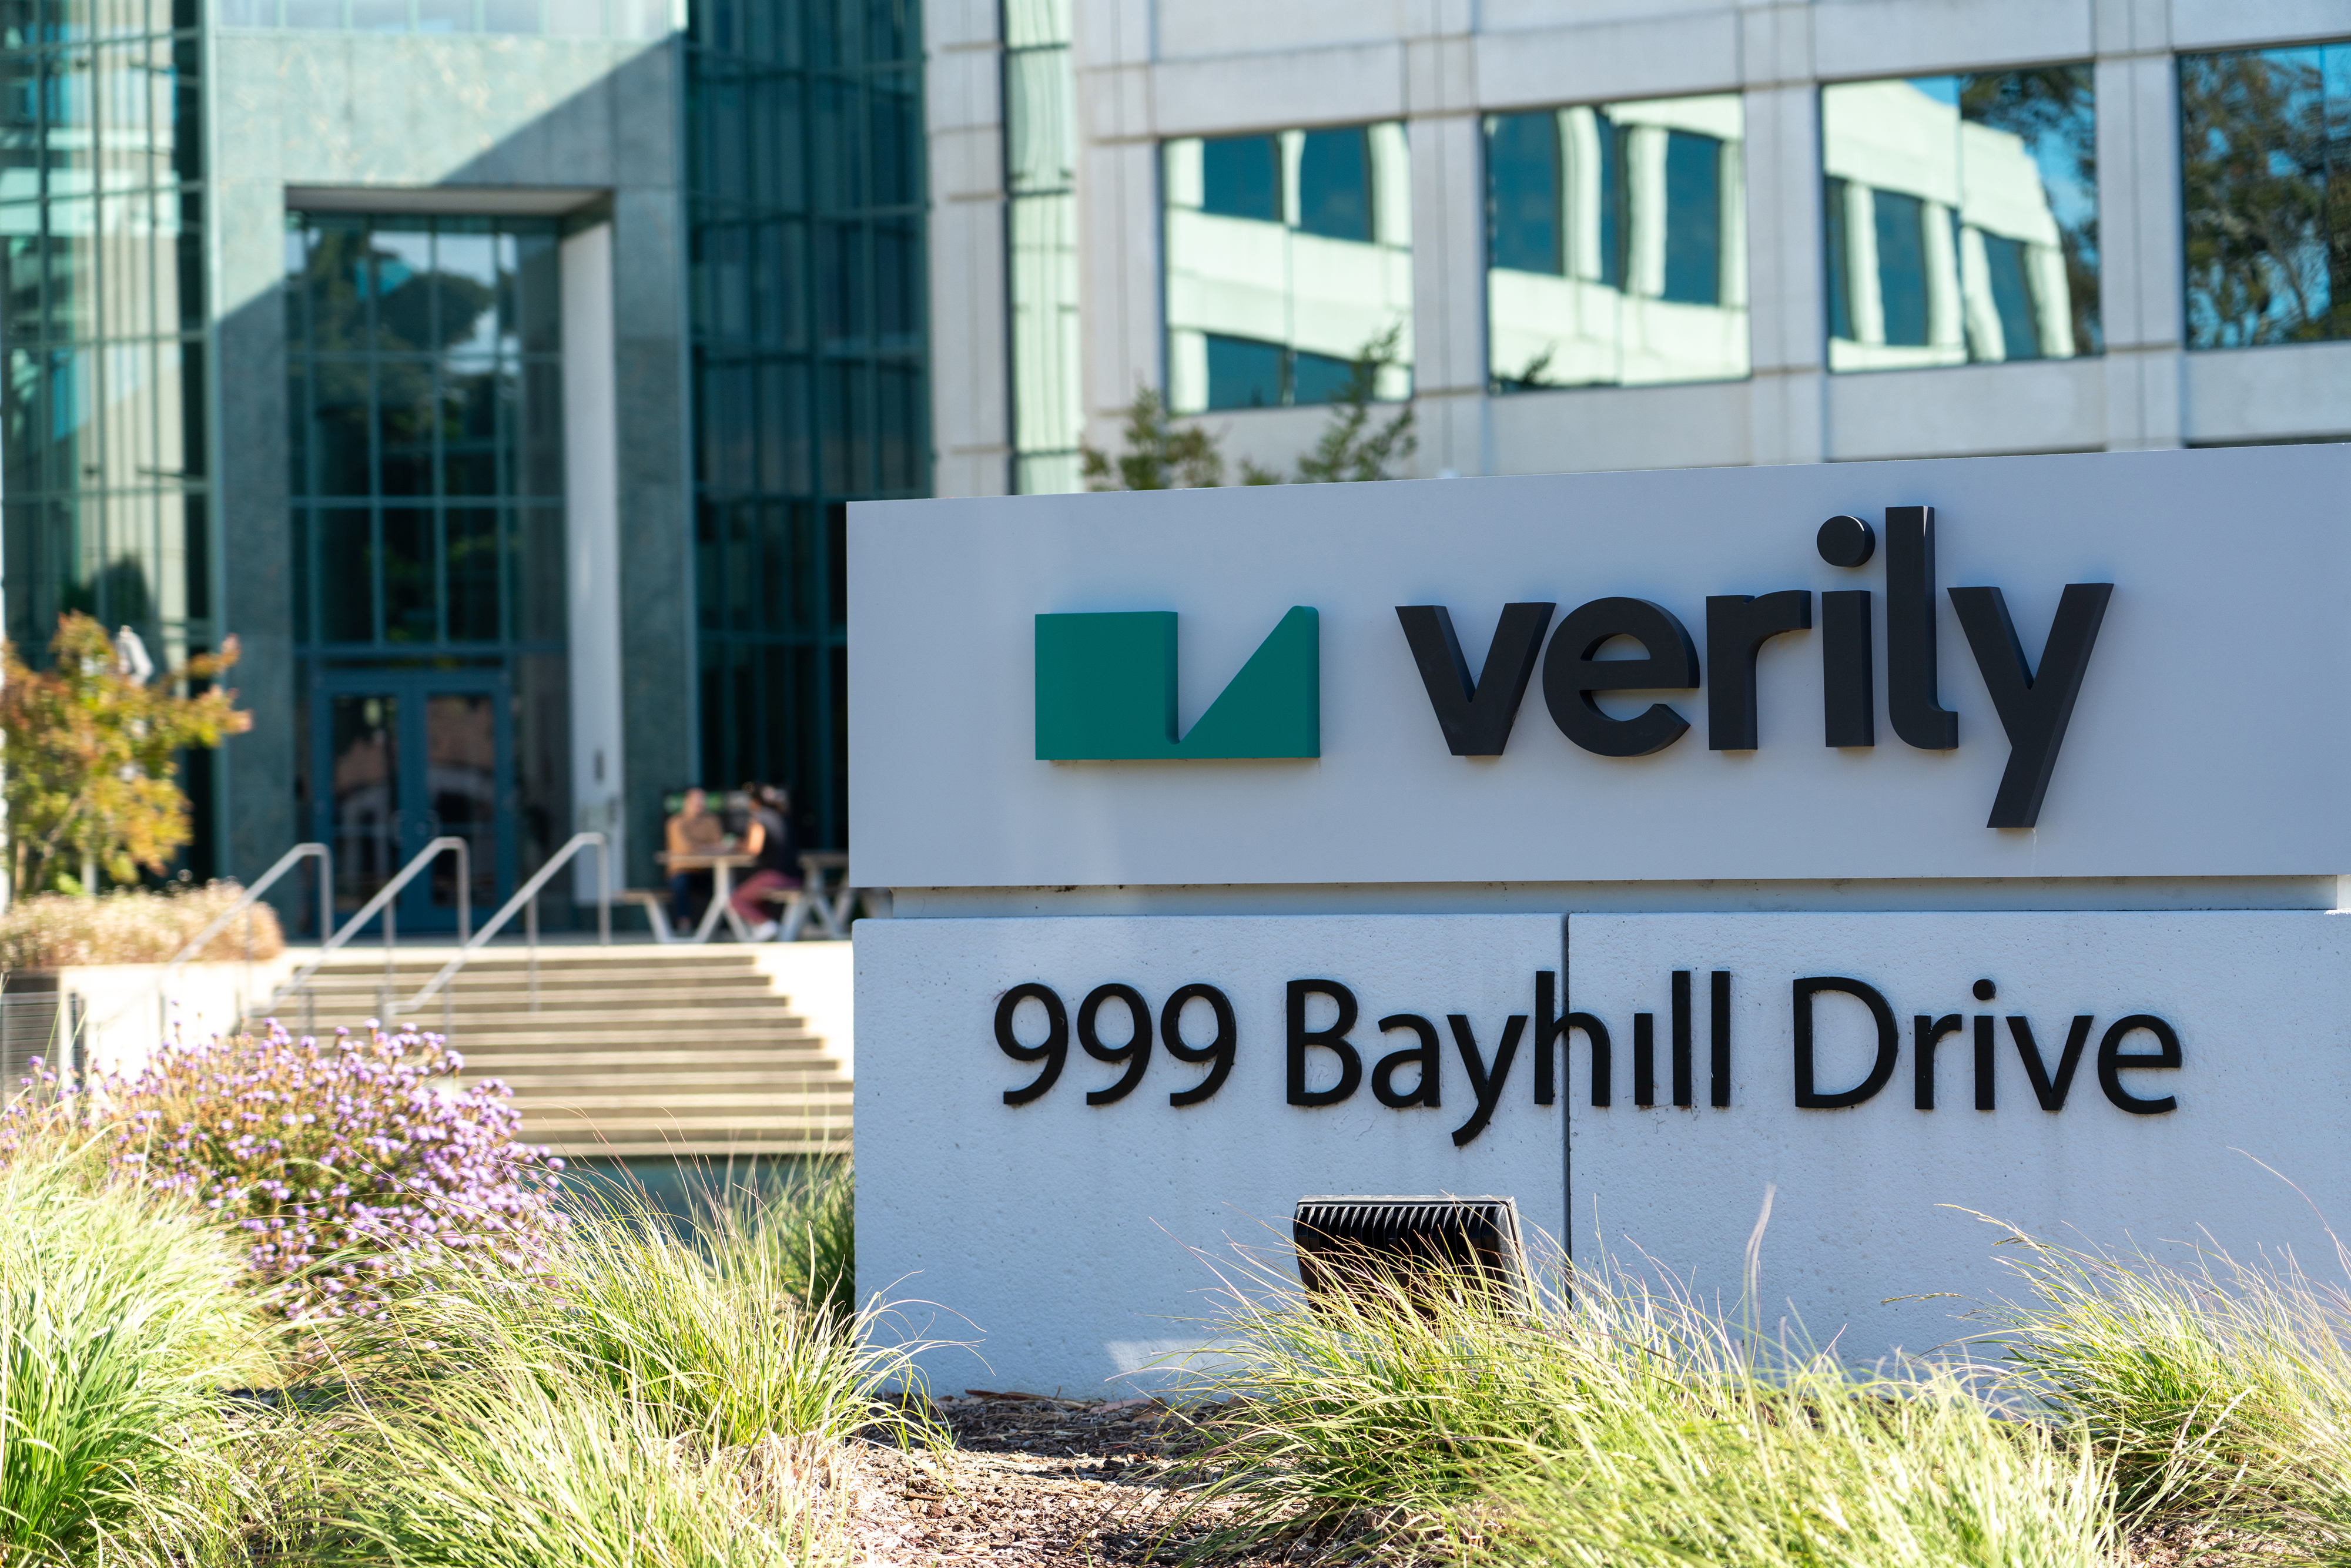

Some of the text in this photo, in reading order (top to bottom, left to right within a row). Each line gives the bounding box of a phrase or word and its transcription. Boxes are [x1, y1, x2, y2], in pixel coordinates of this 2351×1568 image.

[1395, 506, 2115, 832] verily
[994, 970, 2182, 1150] 999 Bayhill Drive
